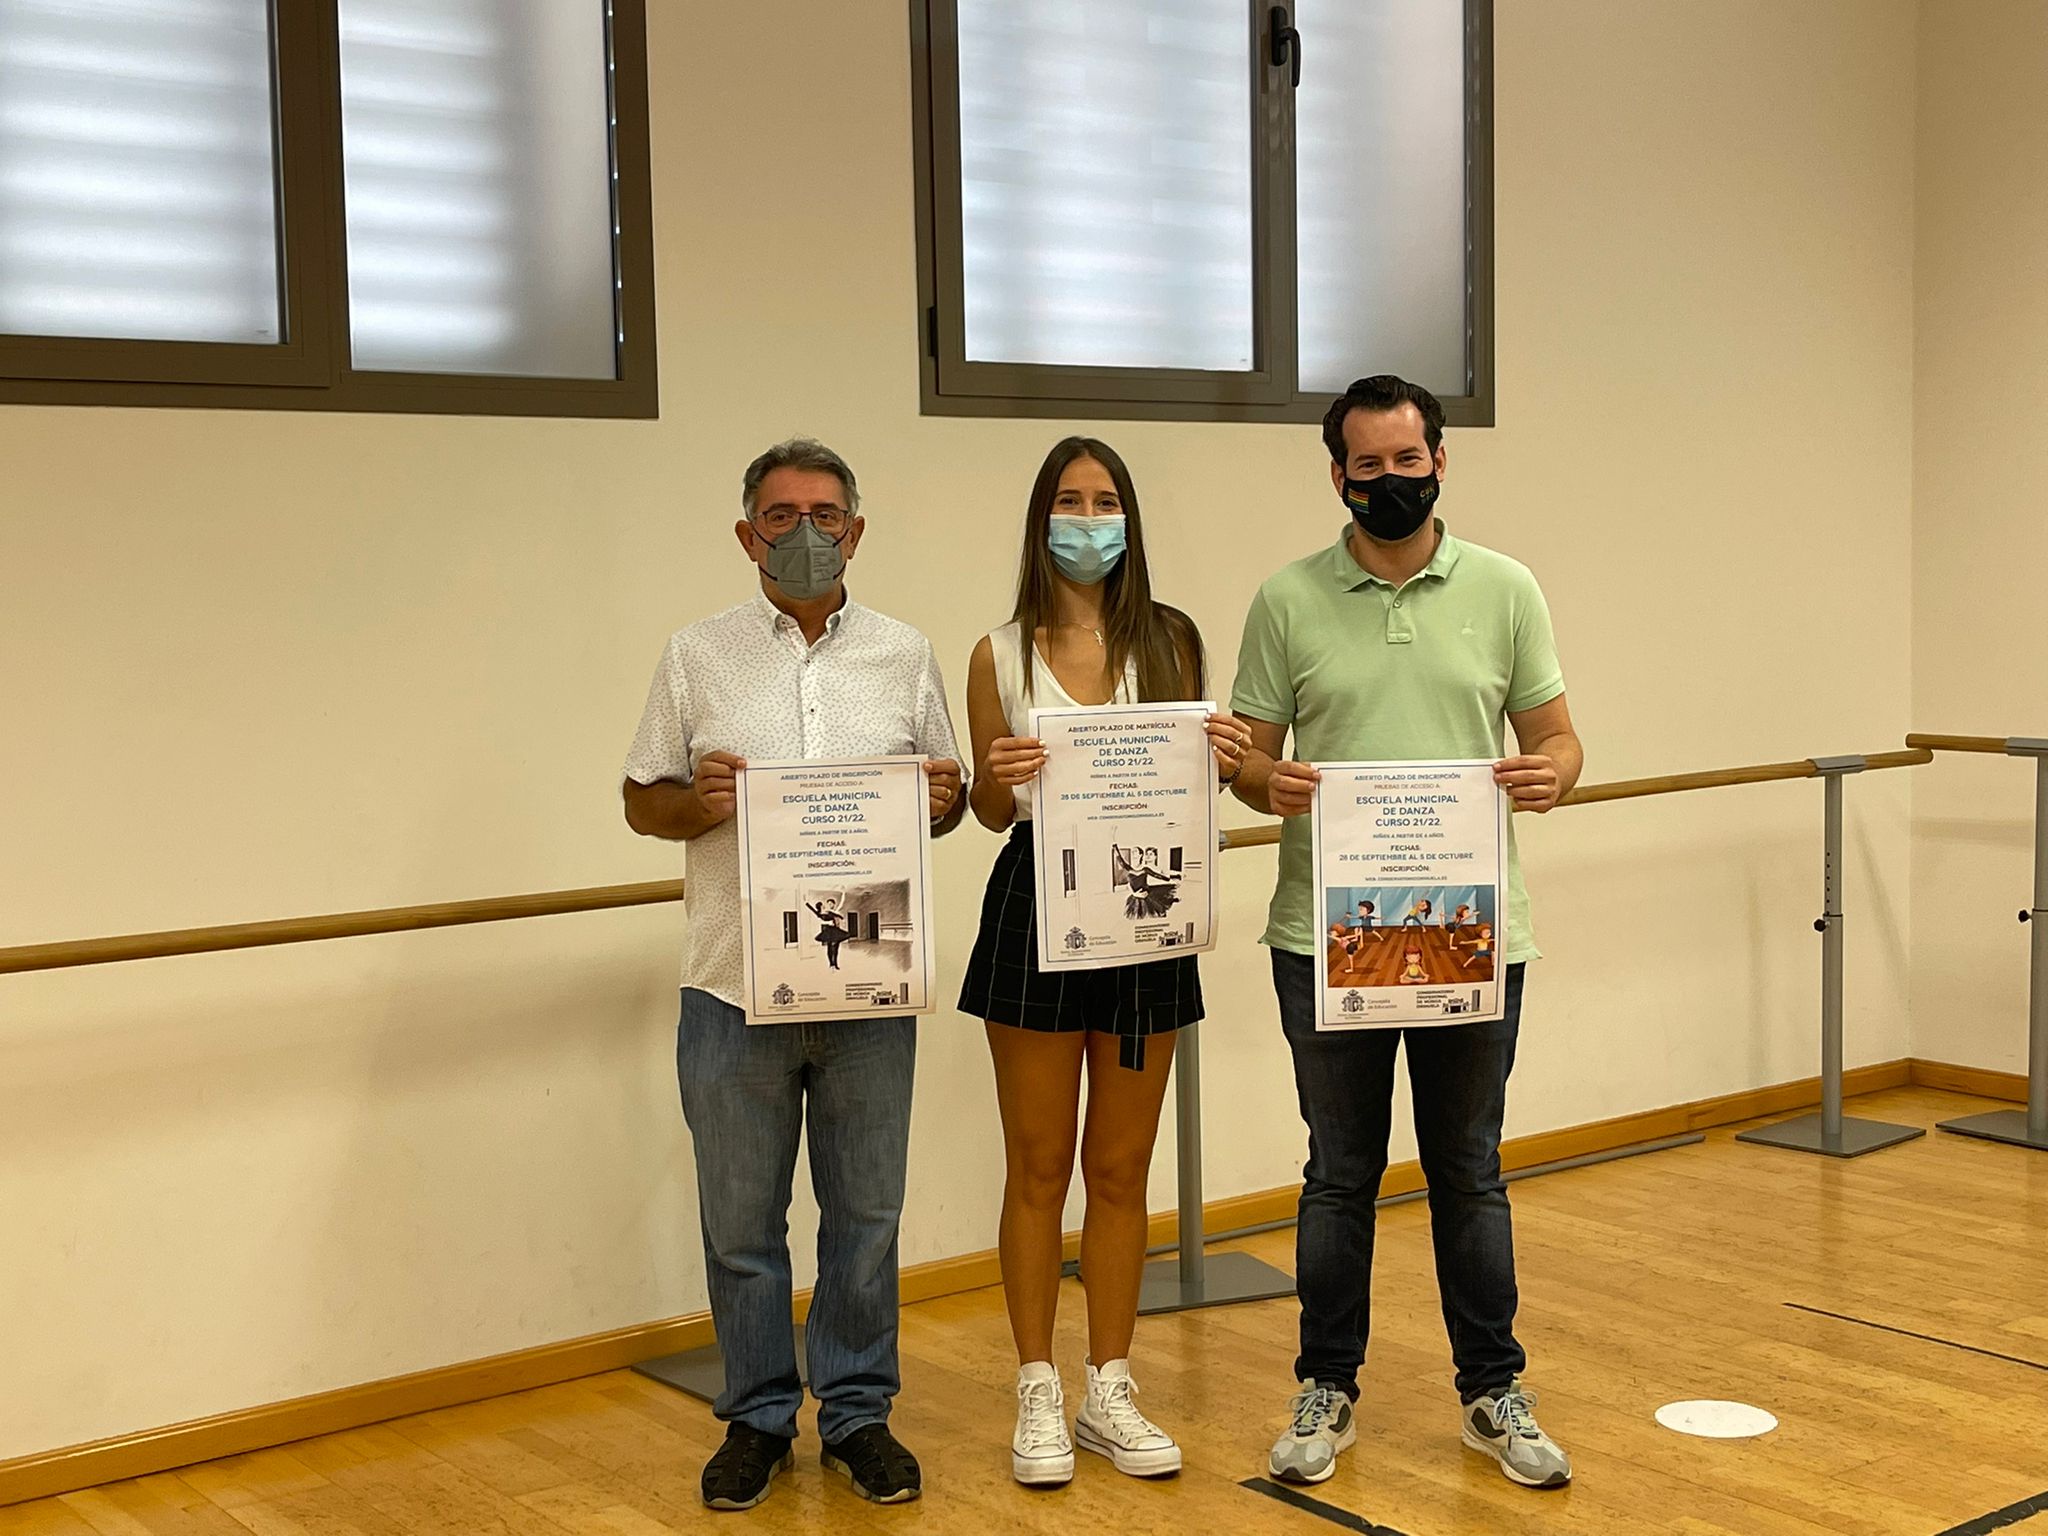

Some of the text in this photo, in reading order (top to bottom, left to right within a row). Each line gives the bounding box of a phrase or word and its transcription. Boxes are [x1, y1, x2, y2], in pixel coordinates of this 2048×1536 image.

[1136, 721, 1176, 730] MATRÍCULA
[1074, 735, 1170, 746] ESCUELA MUNICIPAL
[1114, 747, 1149, 756] DANZA
[1092, 758, 1126, 768] CURSO
[783, 791, 881, 803] ESCUELA MUNICIPAL
[1356, 795, 1459, 804] ESCUELA MUNICIPAL
[825, 803, 858, 812] DANZA
[1399, 807, 1435, 815] DANZA
[802, 815, 836, 824] CURSO
[1376, 818, 1411, 827] CURSO
